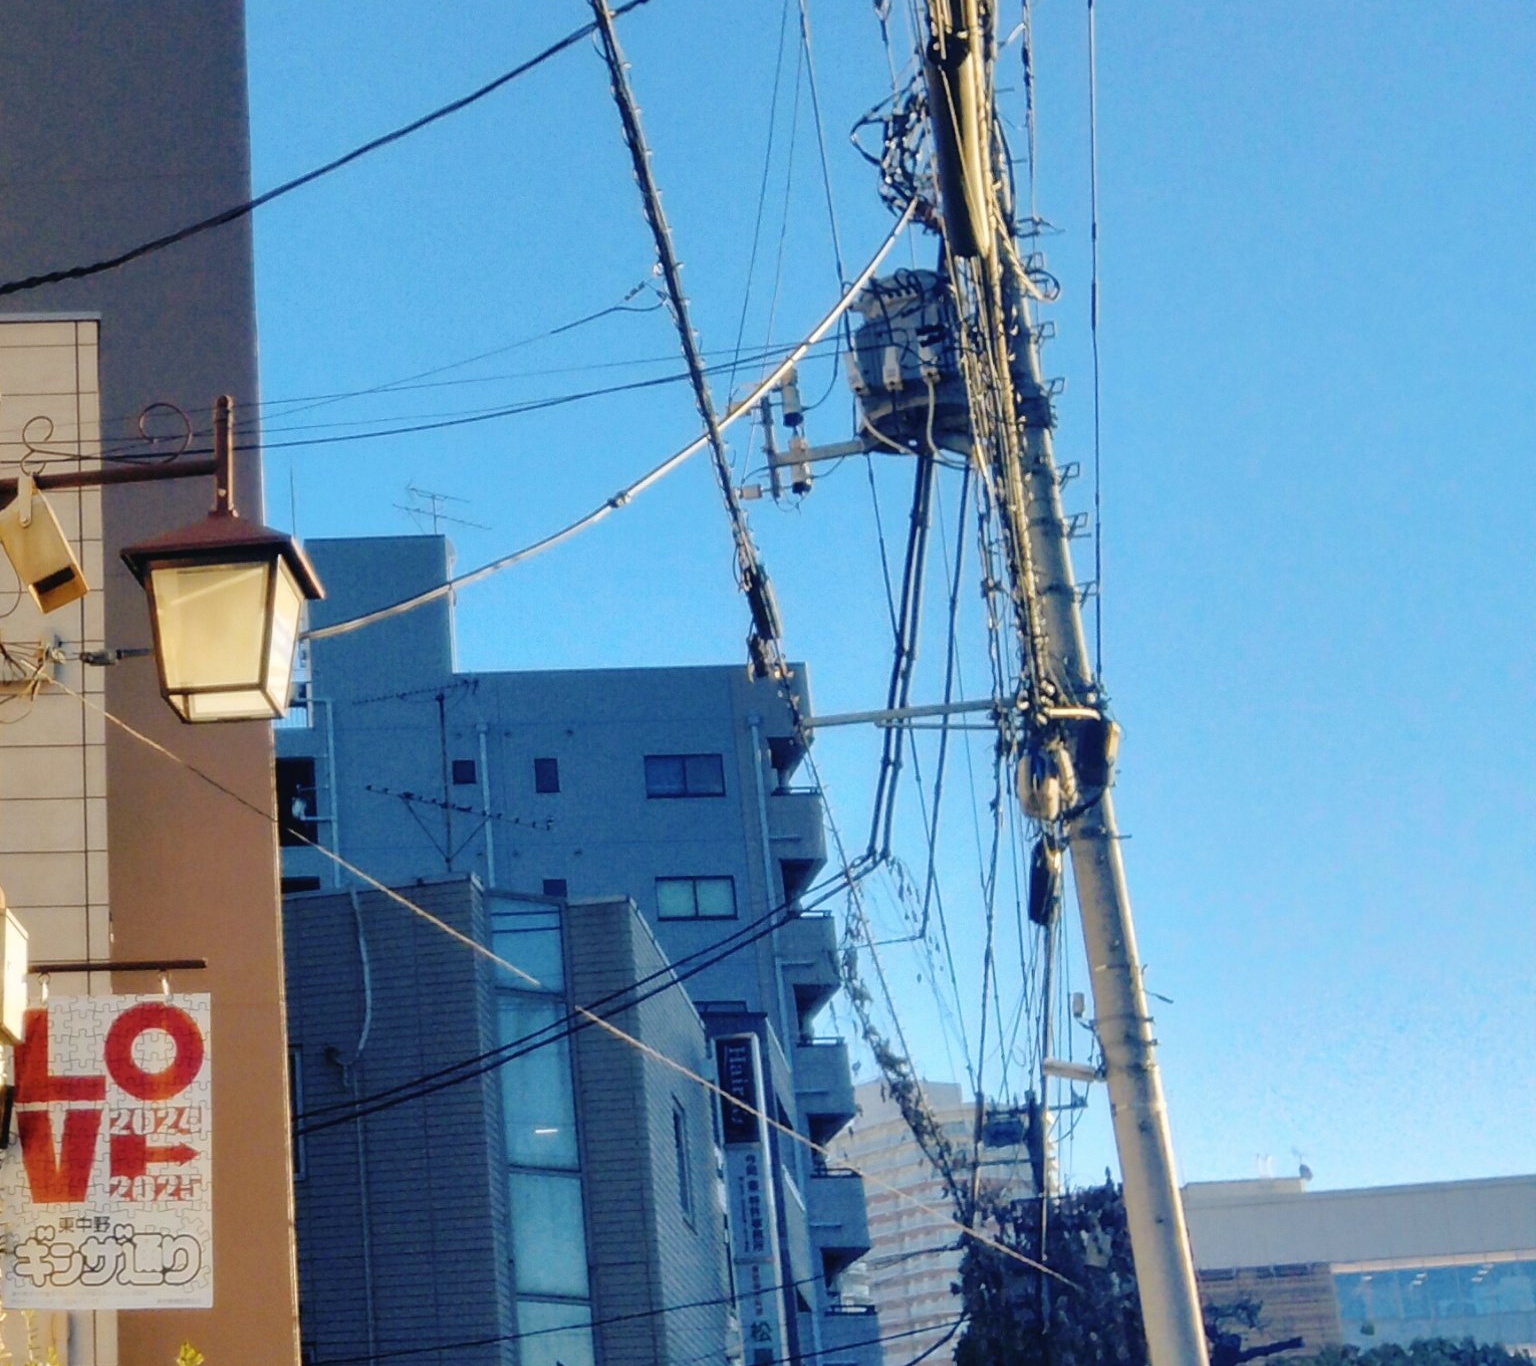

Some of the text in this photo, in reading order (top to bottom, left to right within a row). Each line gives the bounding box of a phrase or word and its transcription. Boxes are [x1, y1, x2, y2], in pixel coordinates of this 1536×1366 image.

[110, 1108, 201, 1135] 2024
[110, 1175, 202, 1203] 2025
[58, 1216, 111, 1233] 東中野
[14, 1223, 202, 1287] ギンザ通り
